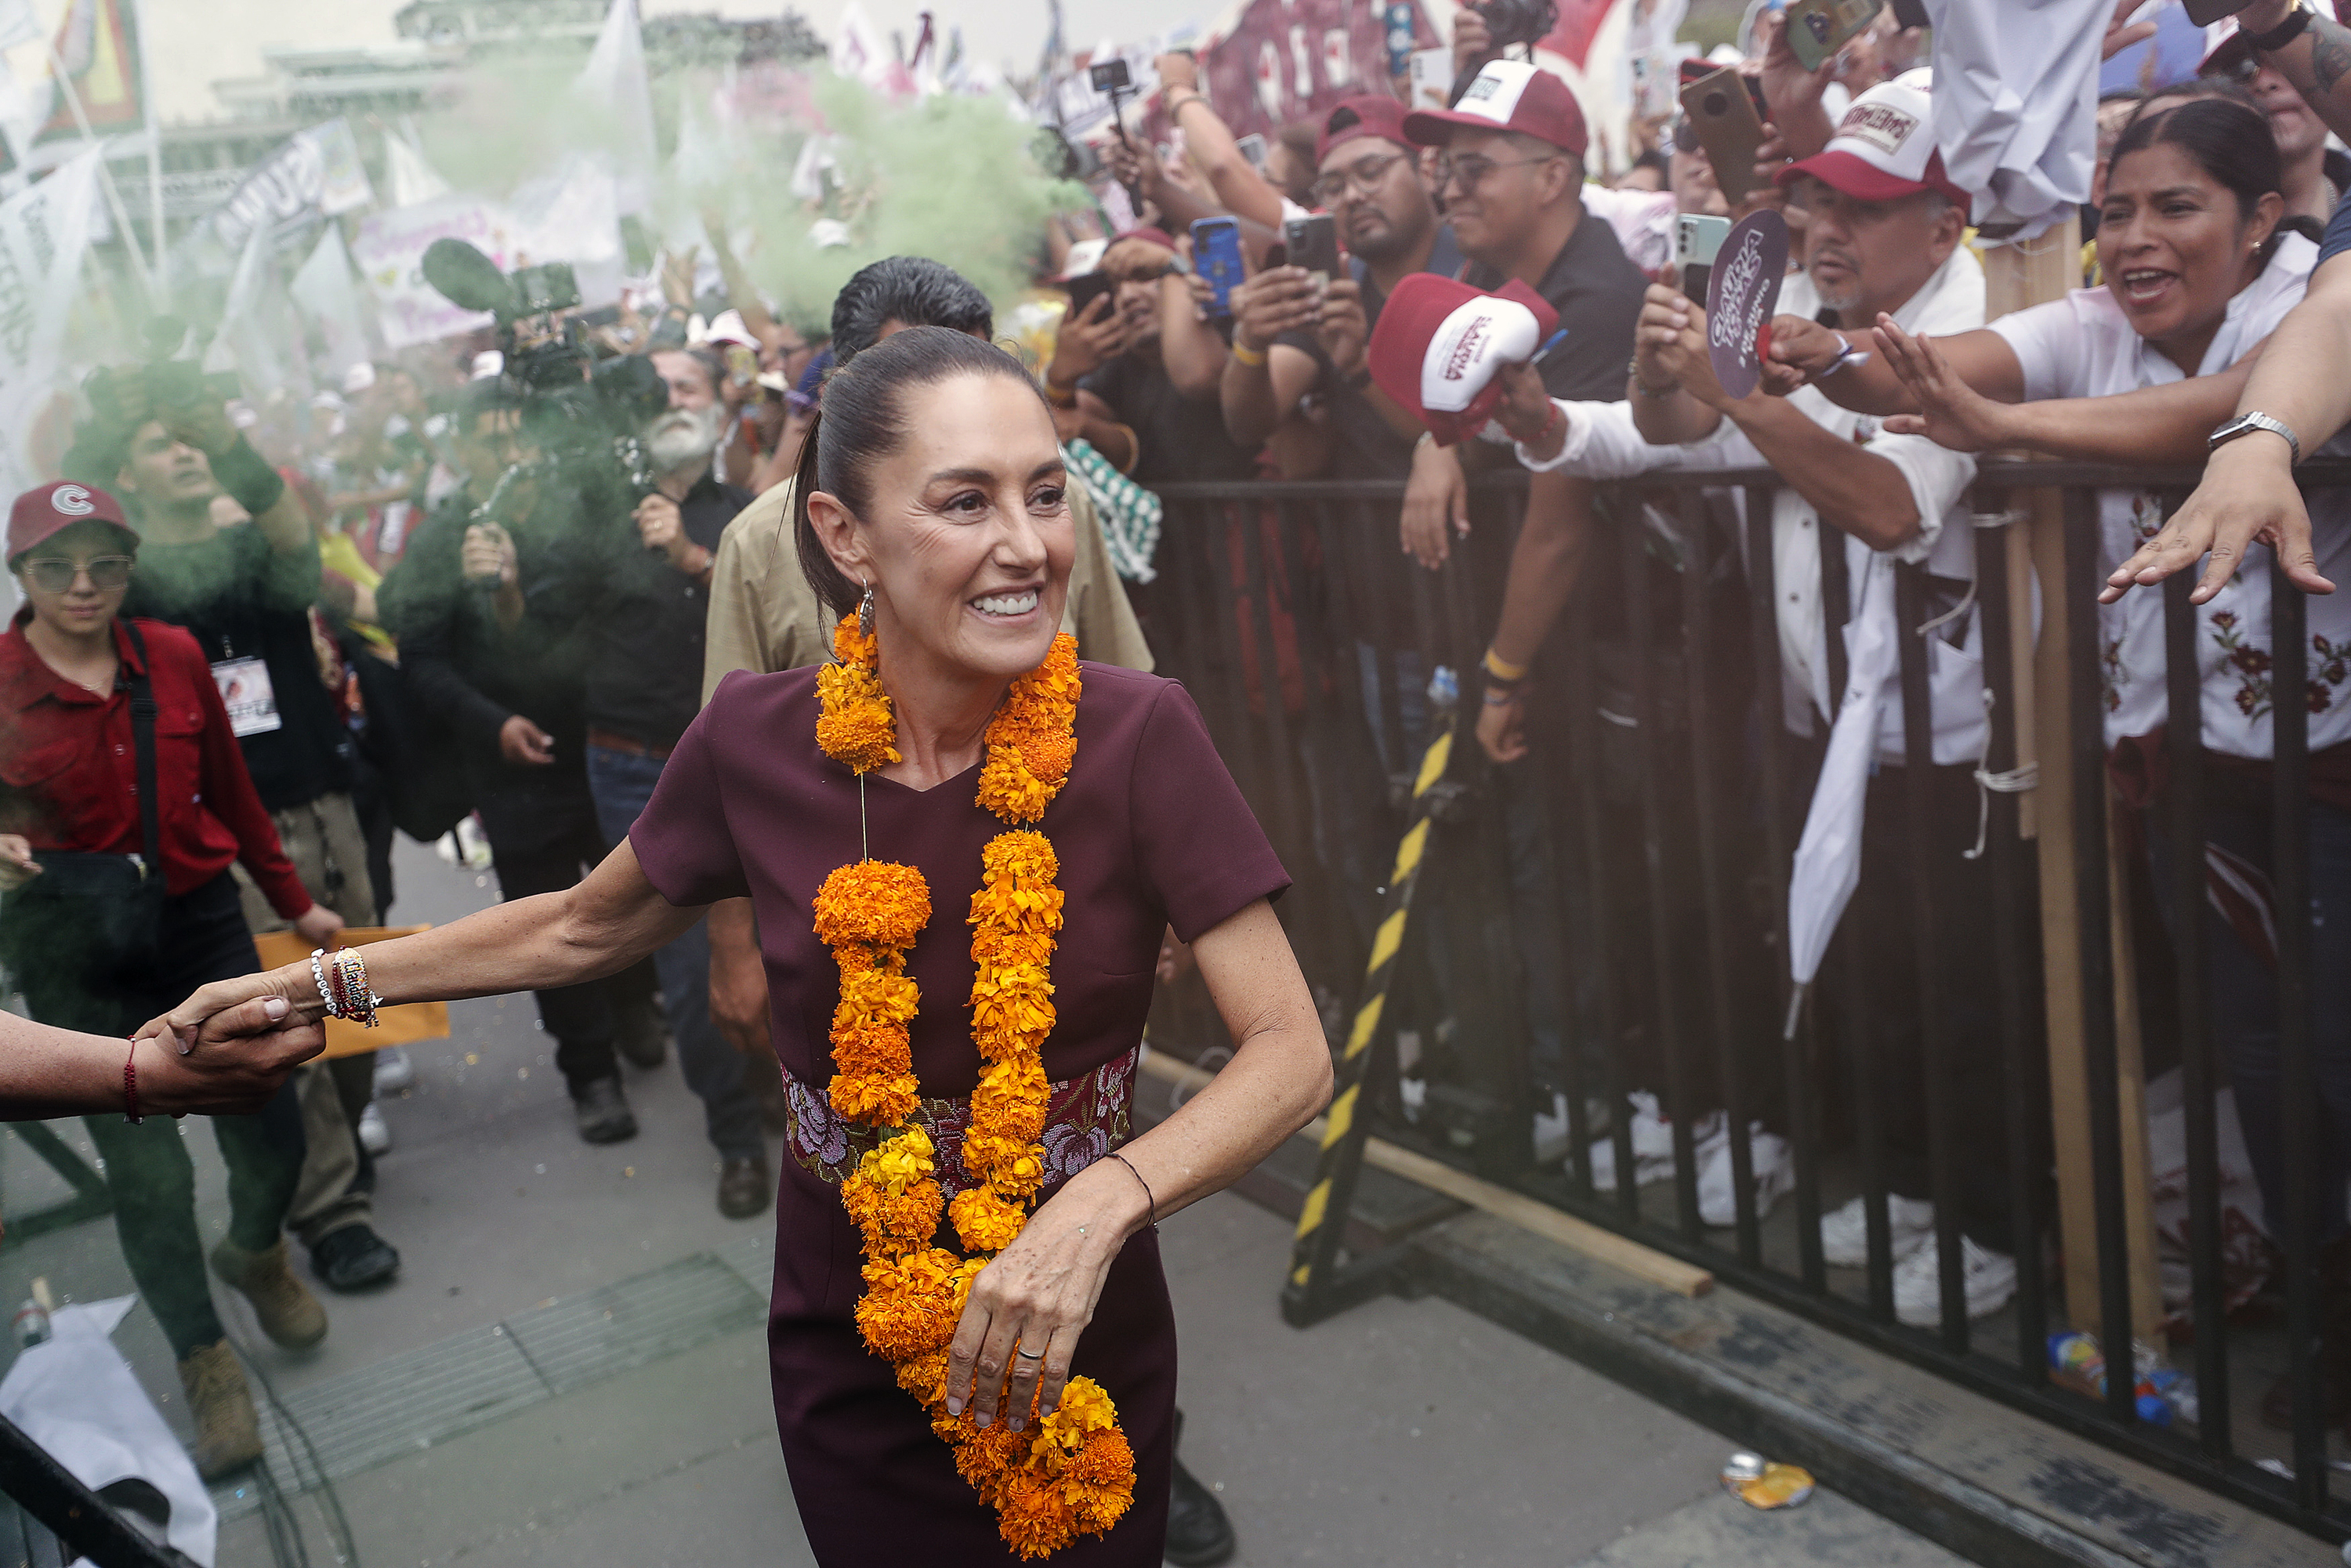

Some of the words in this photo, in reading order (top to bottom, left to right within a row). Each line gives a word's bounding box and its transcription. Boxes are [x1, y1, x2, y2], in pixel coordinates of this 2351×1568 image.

[1712, 230, 1763, 347] CLAUDIA
[1450, 317, 1492, 380] CLAUDIA
[51, 484, 95, 516] C
